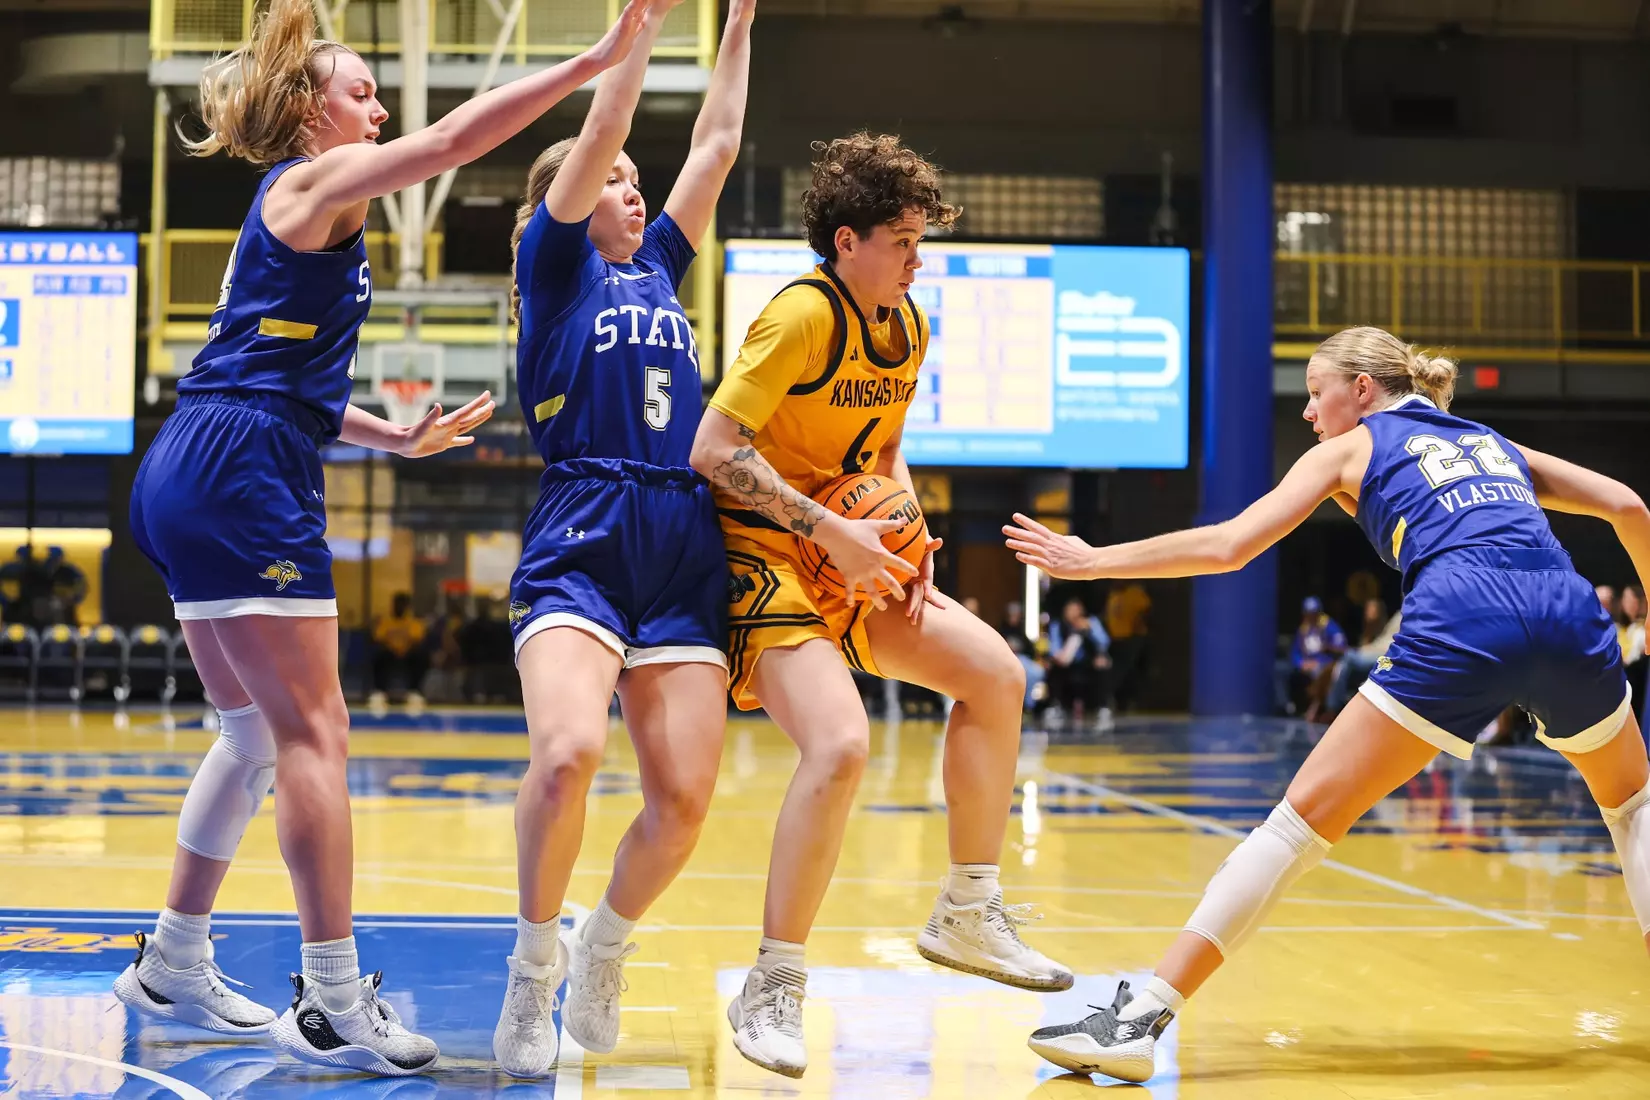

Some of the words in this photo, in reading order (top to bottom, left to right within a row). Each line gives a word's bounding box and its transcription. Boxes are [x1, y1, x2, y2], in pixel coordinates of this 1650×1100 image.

[643, 366, 672, 431] 5
[829, 376, 892, 408] KANSAS
[1404, 433, 1528, 490] 22
